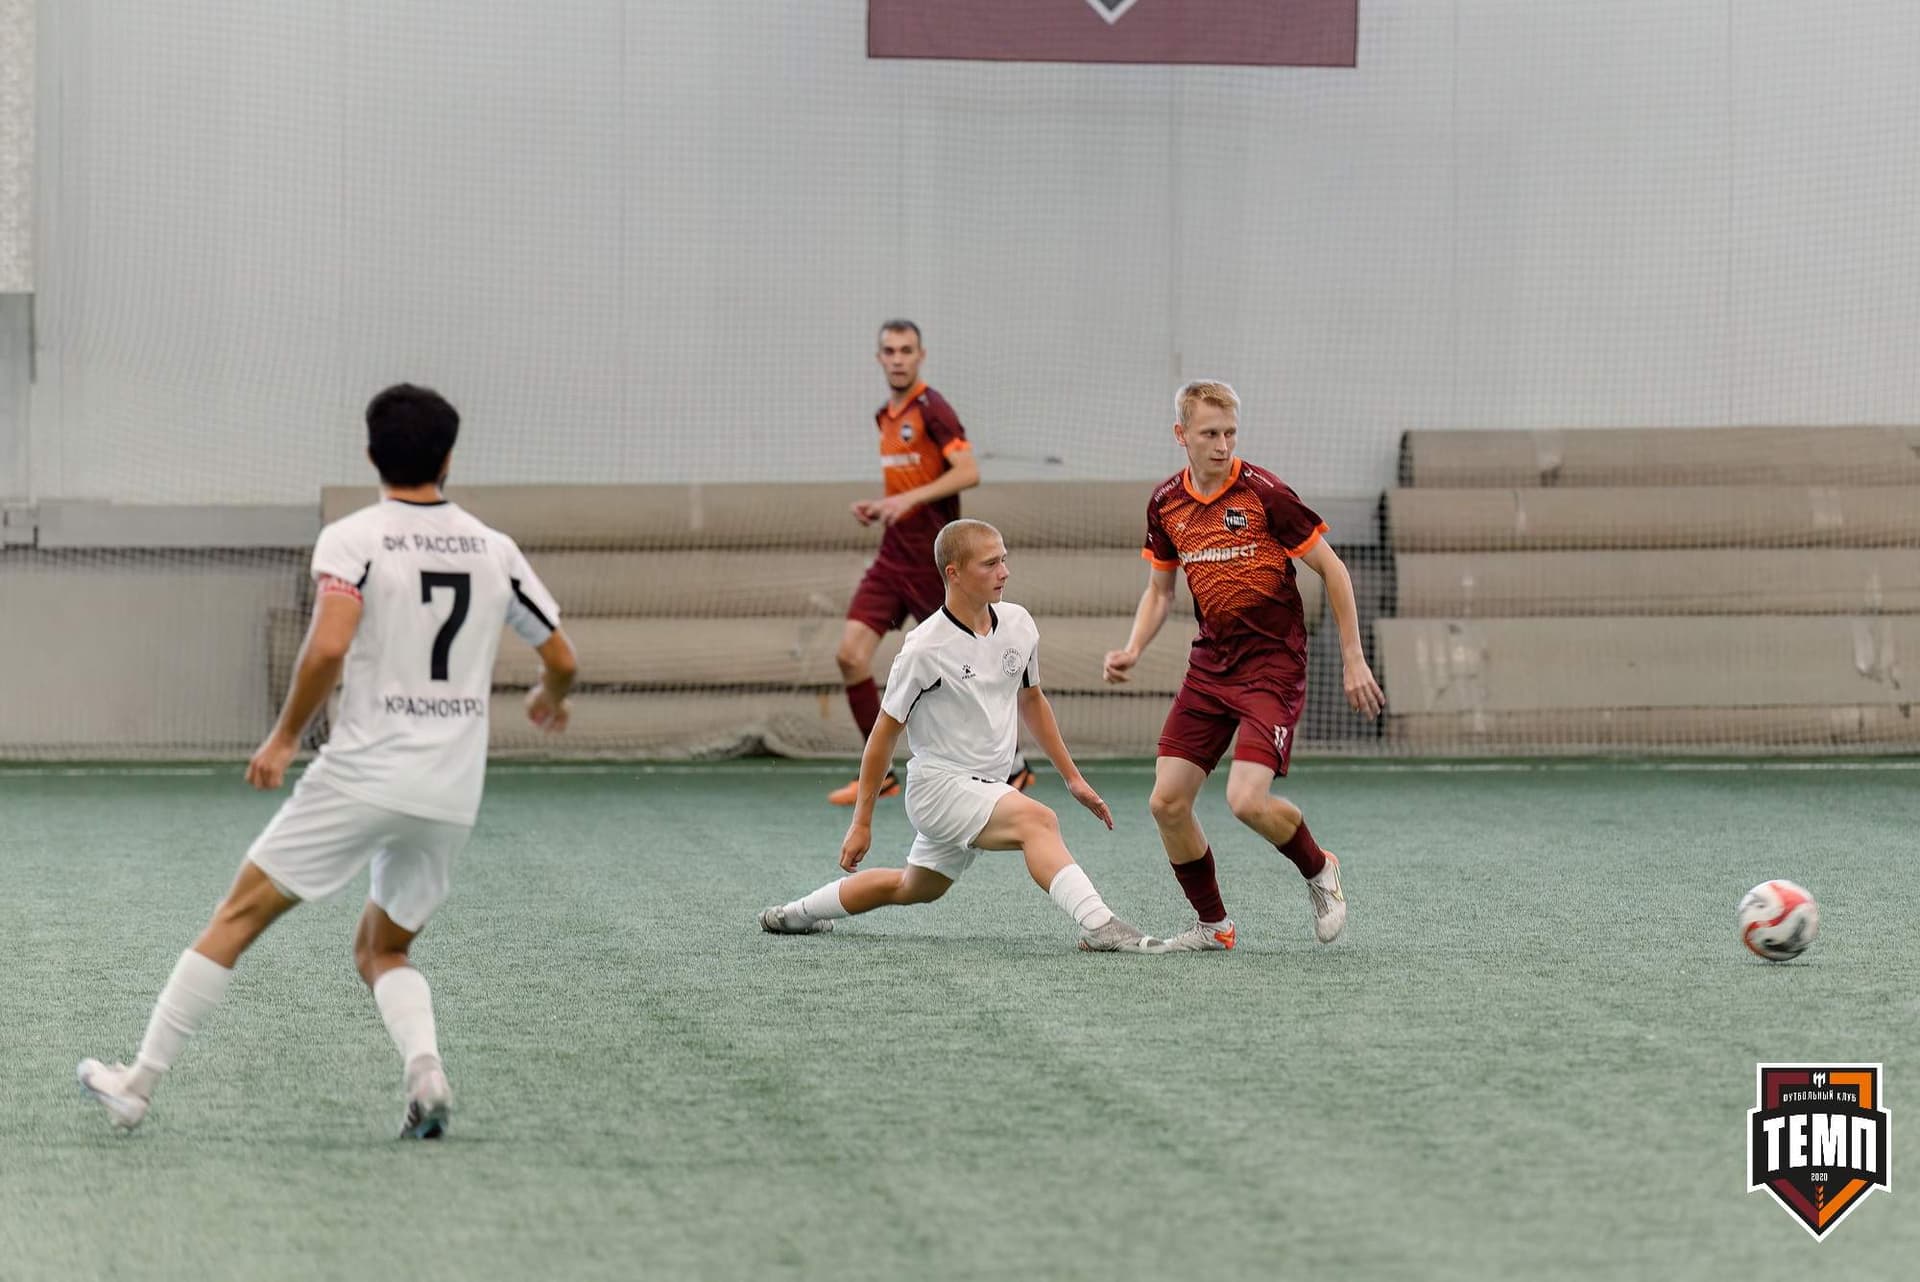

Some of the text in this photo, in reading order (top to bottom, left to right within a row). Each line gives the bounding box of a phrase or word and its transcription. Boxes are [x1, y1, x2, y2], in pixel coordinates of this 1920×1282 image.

[384, 534, 488, 554] ФК РАССВЕТ
[421, 571, 470, 680] 7
